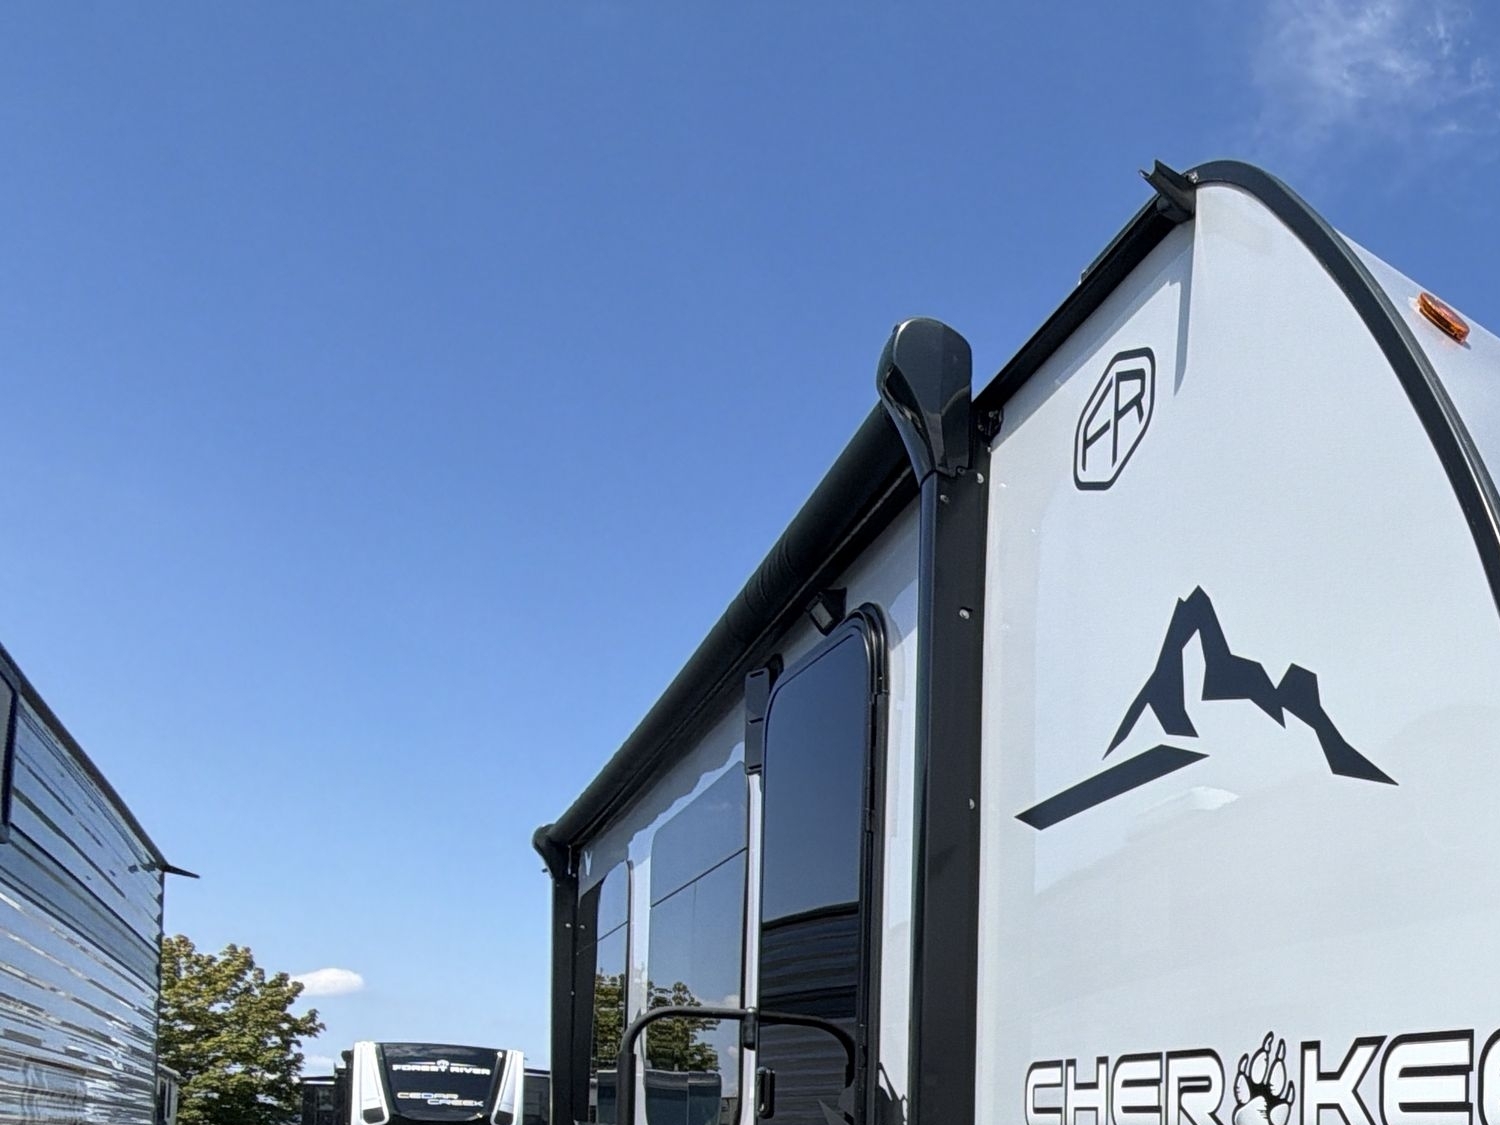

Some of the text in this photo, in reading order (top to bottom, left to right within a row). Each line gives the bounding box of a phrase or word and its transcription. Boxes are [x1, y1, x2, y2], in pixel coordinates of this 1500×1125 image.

[392, 1064, 491, 1075] FOREST RIVER
[427, 1099, 484, 1107] CREEK
